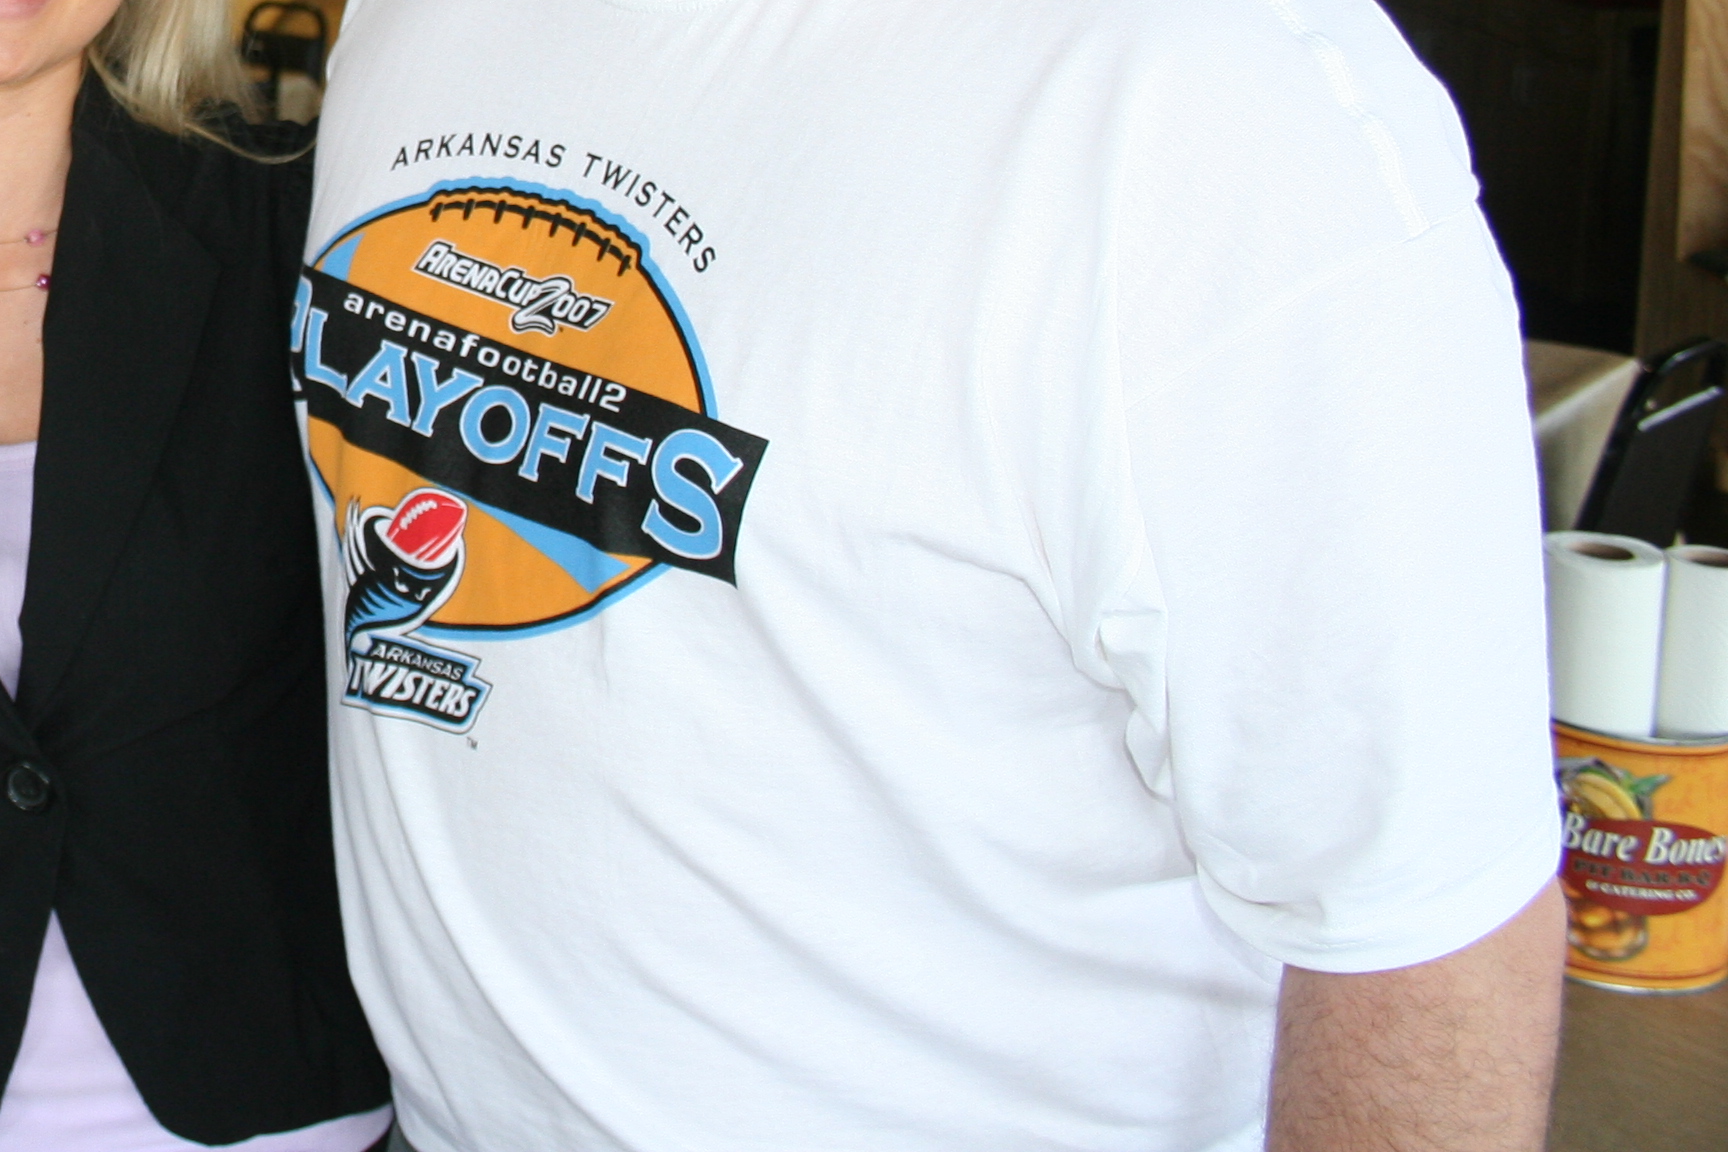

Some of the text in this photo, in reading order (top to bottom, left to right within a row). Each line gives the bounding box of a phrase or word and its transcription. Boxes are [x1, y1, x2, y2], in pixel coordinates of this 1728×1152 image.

[391, 133, 717, 274] ARKANSAS TWISTERS
[343, 291, 628, 414] arenafootball2
[350, 657, 476, 718] TWISTERS
[373, 642, 464, 681] ARKANSAS
[1564, 811, 1728, 866] Bare Bones
